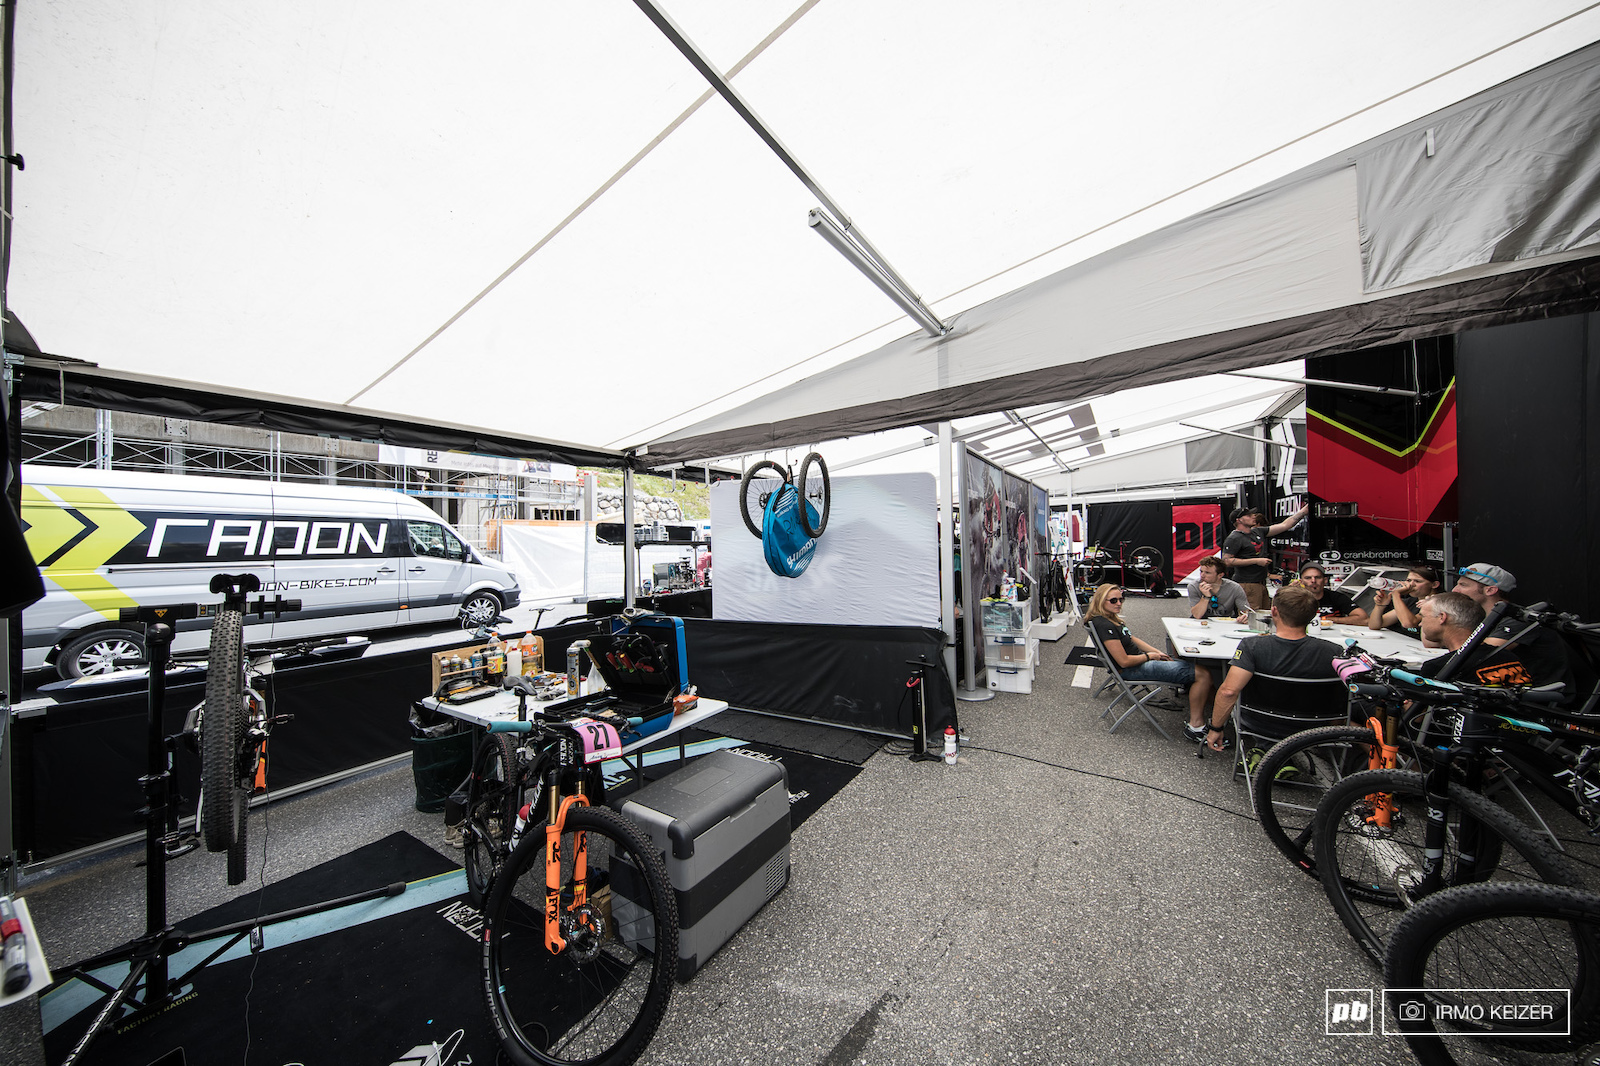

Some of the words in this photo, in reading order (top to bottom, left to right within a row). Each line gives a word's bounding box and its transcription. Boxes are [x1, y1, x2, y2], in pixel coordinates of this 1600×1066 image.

[147, 518, 388, 558] RADON
[1176, 522, 1221, 550] DI
[787, 537, 817, 569] SHIMAN
[1343, 550, 1409, 560] crankbrothers
[258, 577, 378, 592] DON-BIKES.COM
[586, 723, 611, 751] 27
[1427, 806, 1444, 821] 32
[549, 897, 558, 924] FOX
[163, 992, 199, 1012] RACING
[483, 941, 508, 1040] SCHWALBE
